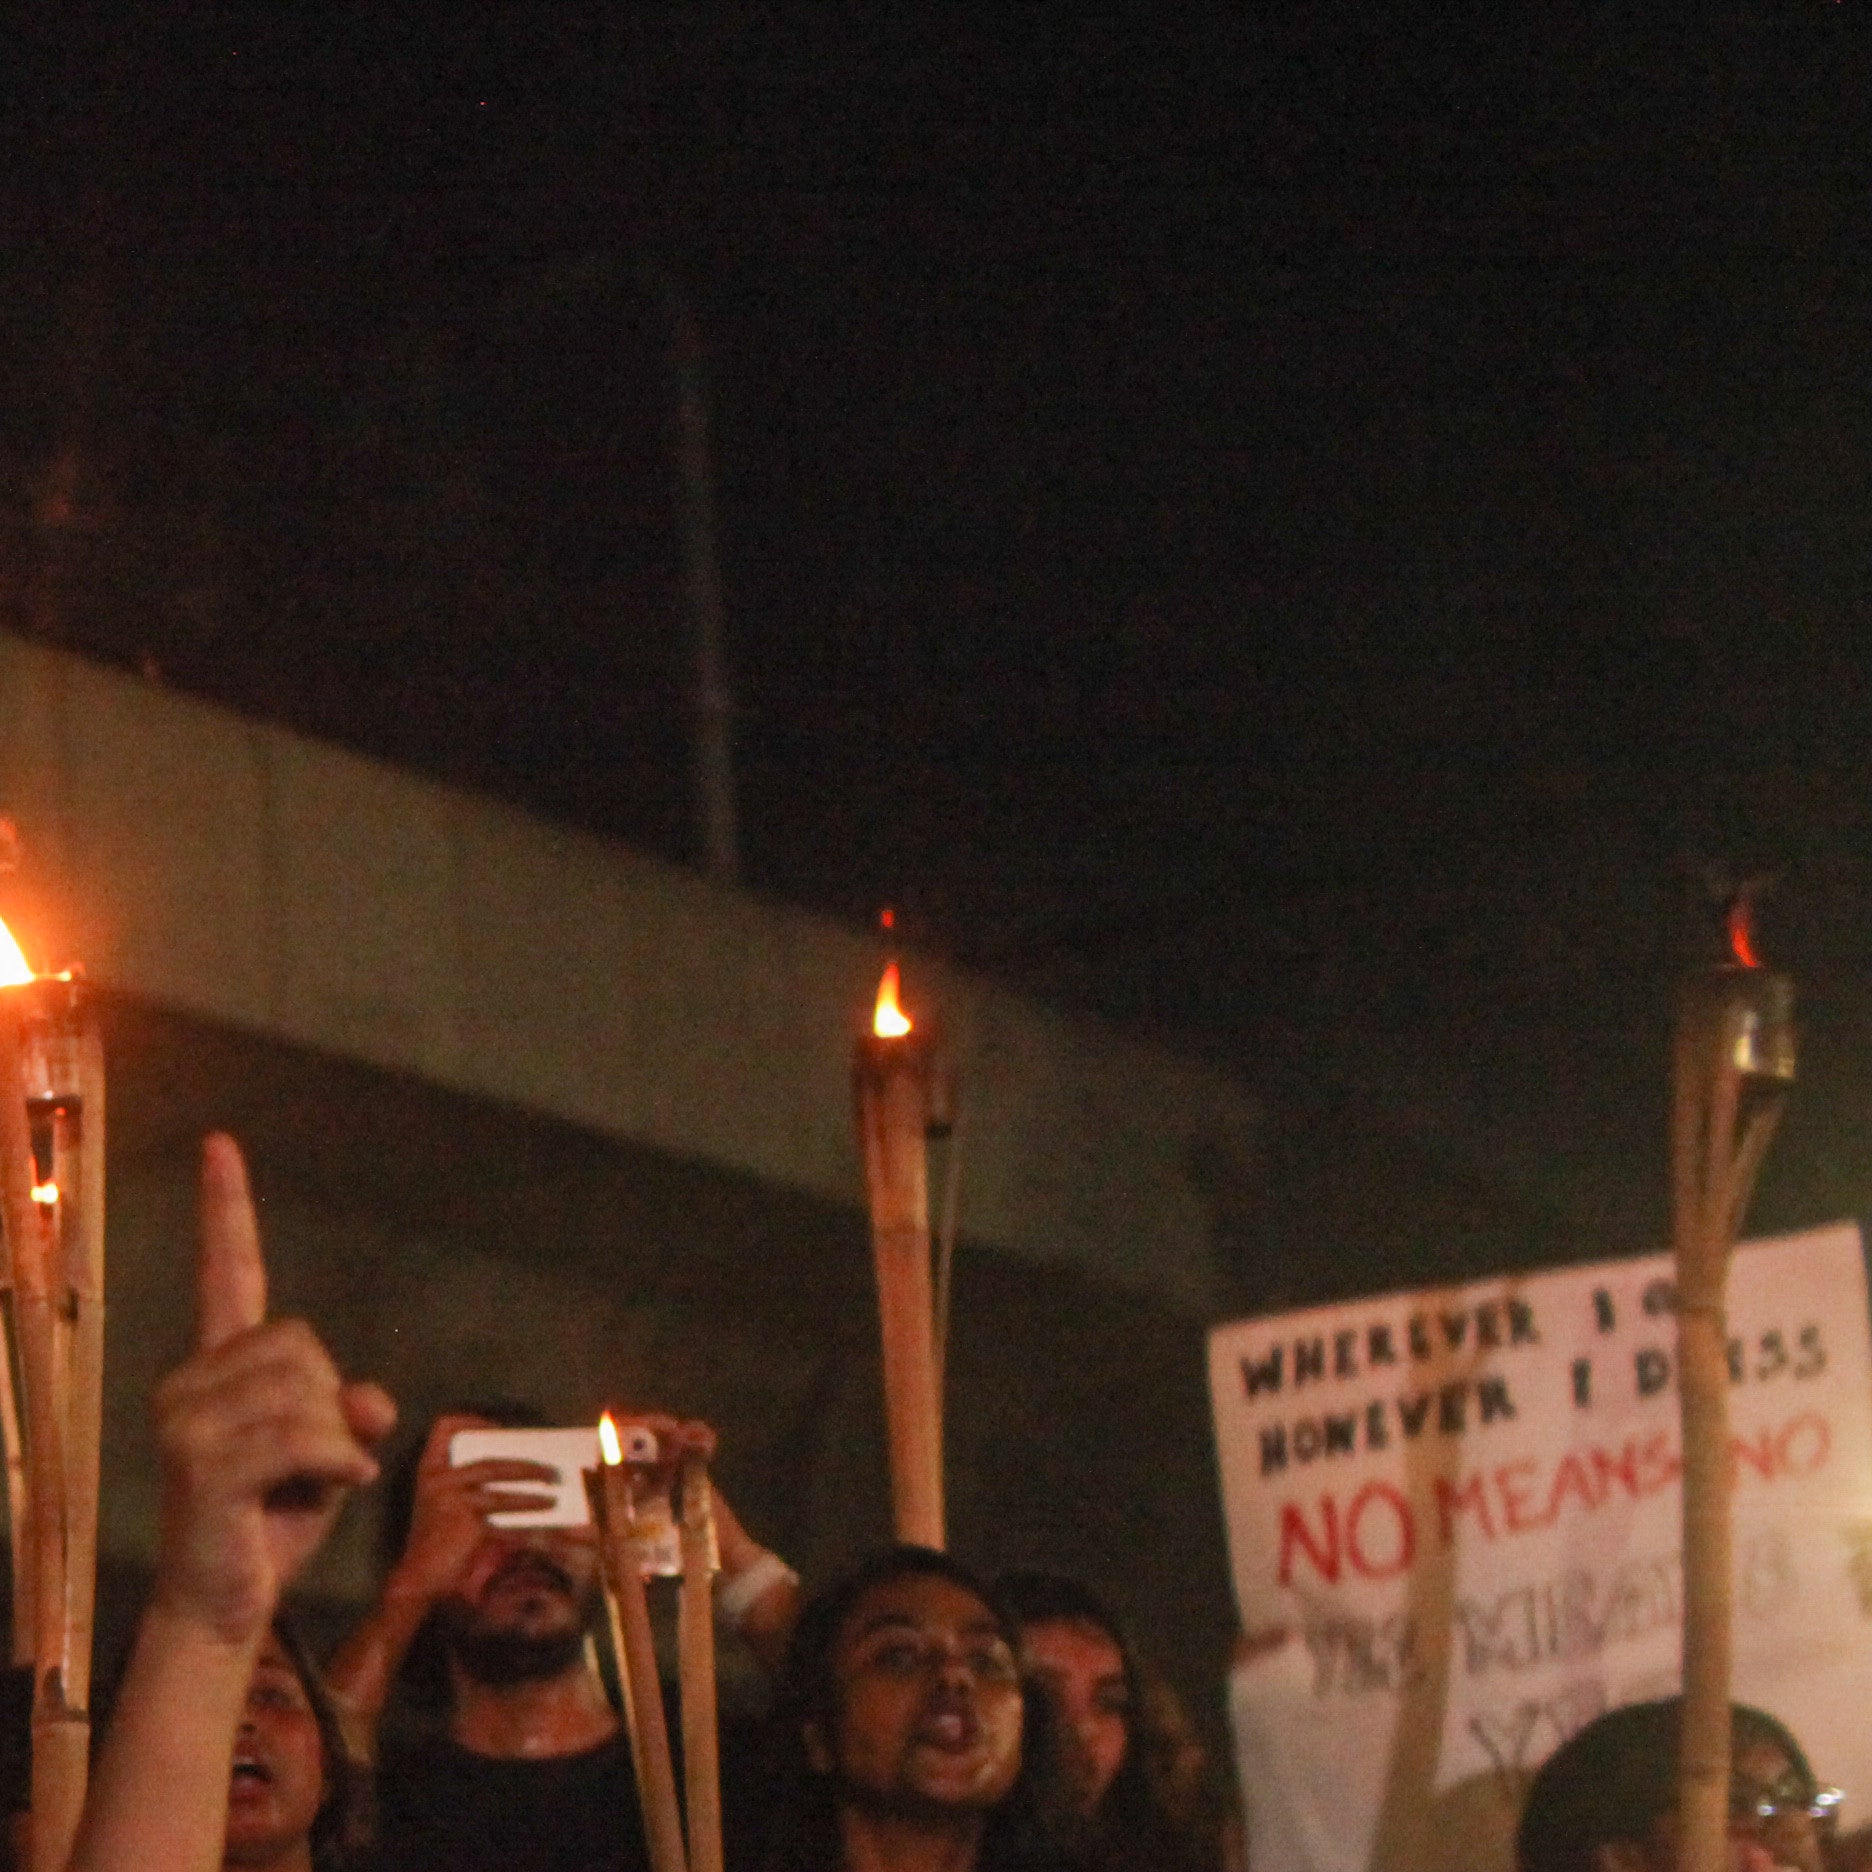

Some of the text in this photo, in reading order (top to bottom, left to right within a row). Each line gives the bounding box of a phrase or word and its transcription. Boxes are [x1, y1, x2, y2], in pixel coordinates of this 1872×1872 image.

[1634, 1324, 1829, 1400] DESS
[1275, 1410, 1832, 1589] NO MEANS NO
